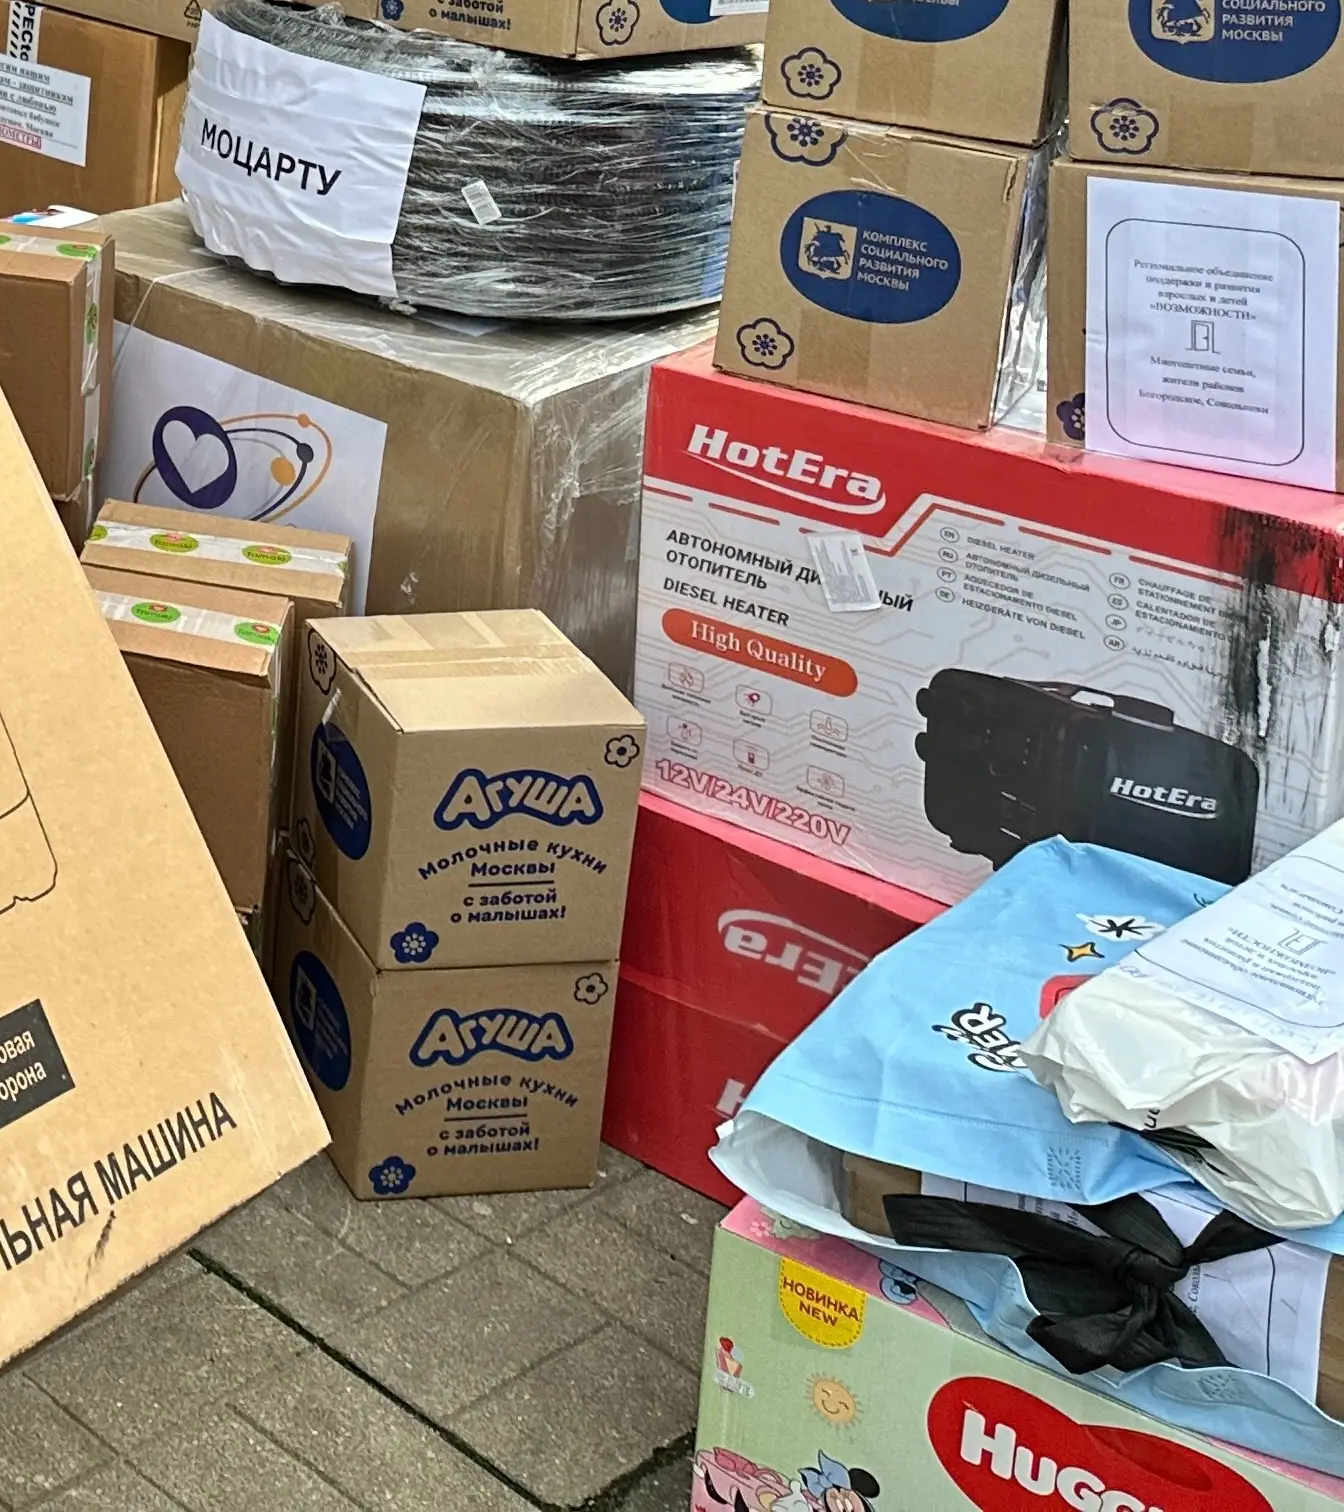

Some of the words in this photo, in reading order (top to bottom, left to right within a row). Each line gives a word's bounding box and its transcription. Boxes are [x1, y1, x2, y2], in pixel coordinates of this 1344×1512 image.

[428, 8, 437, 18] о
[439, 6, 511, 31] малышах!
[1222, 13, 1295, 28] РАЗВИТИЯ
[1221, 27, 1284, 43] МОСКВЫ
[201, 118, 342, 196] МОЦАРТУ
[862, 229, 928, 252] КОМПЛЕКС
[858, 258, 921, 280] РАЗВИТИЯ
[860, 243, 949, 272] СОЦИАЛЬНОГО
[856, 271, 910, 292] МОСКВЫ
[688, 424, 882, 502] HotEra
[666, 530, 793, 576] АВТОНОМНЫЙ
[1000, 545, 1036, 561] HEATER
[666, 549, 767, 589] ОТОПИТЕЛЬ
[663, 577, 718, 605] DIESEL
[723, 595, 790, 627] HEATER
[1050, 623, 1085, 639] DIESEL
[691, 620, 741, 653] High
[746, 639, 827, 683] Quality
[1110, 776, 1217, 812] HotEra
[417, 839, 539, 880] Молочные
[546, 841, 608, 875] кухни
[470, 862, 556, 878] Москвы
[463, 895, 473, 906] с
[479, 889, 558, 906] заботой
[451, 912, 462, 924] о
[467, 906, 566, 922] малышах!
[394, 1074, 512, 1116] Молочные
[519, 1076, 579, 1108] кухни
[446, 1096, 528, 1112] Москвы
[439, 1129, 450, 1141] с
[455, 1123, 531, 1140] заботой
[94, 1091, 238, 1207] МАШИНА
[427, 1146, 438, 1157] о
[444, 1139, 539, 1157] малышах!
[782, 1275, 861, 1324] НОВИНКА
[799, 1299, 838, 1328] NEW
